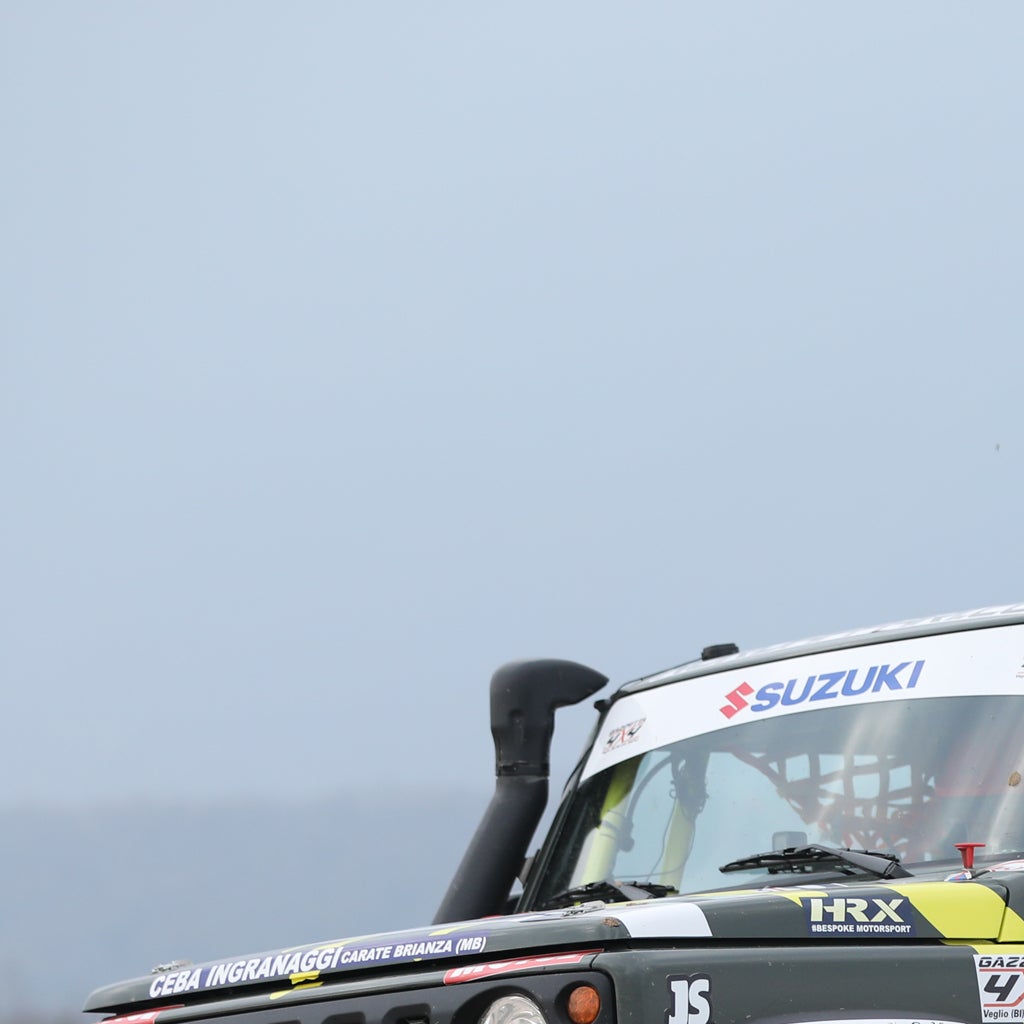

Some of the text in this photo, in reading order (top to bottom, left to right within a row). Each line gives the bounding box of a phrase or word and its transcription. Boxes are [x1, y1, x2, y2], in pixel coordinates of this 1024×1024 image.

[750, 660, 926, 713] SUZUKI
[810, 898, 904, 922] HRX
[856, 925, 911, 933] MOTORSPORT
[148, 936, 486, 998] CEBA INGRANAGGI CARATE BRIANZA (MB)
[983, 1009, 1009, 1020] Veglio
